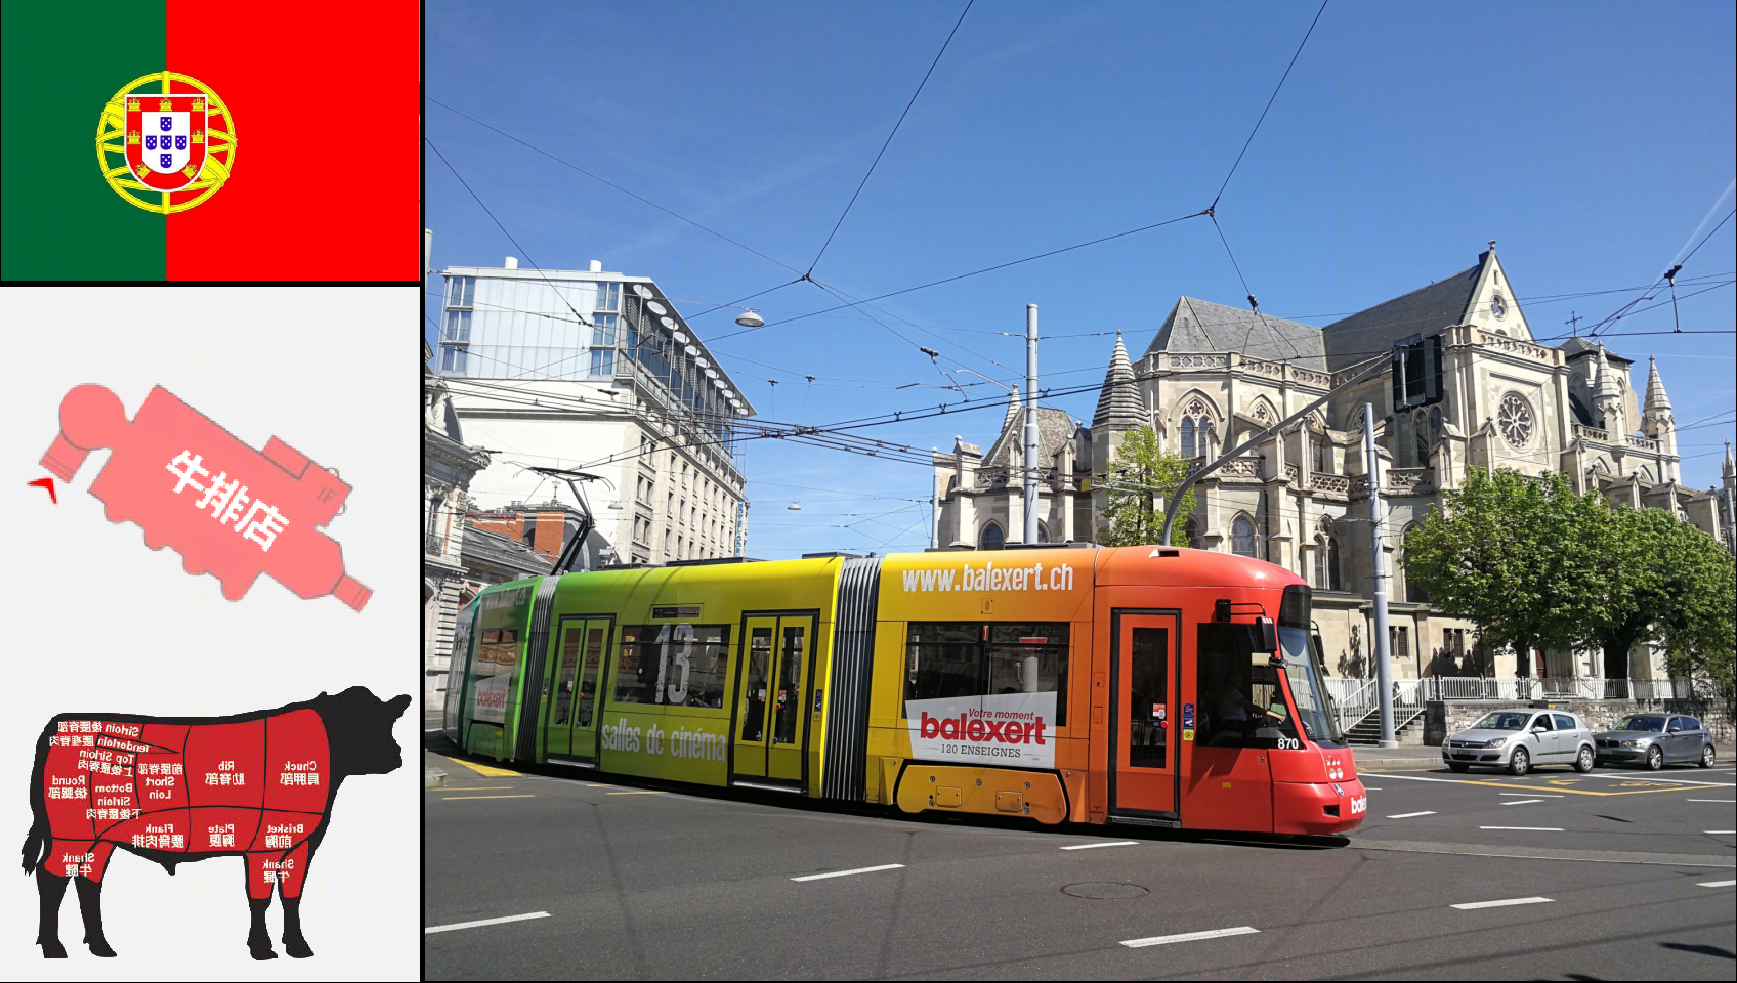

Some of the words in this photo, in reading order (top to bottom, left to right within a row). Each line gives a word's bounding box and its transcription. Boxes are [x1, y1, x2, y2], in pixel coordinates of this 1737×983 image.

[165, 450, 290, 552] 牛排店
[902, 561, 1073, 592] www.balexert.ch
[653, 622, 694, 703] 13
[920, 712, 1047, 745] balexert
[969, 708, 992, 719] Votre
[994, 711, 1034, 720] moment
[602, 718, 641, 753] salles
[646, 723, 665, 755] de
[670, 725, 726, 762] cinéma
[941, 743, 959, 754] 120
[960, 745, 1021, 758] ENSEIGNES
[1277, 737, 1299, 750] 870
